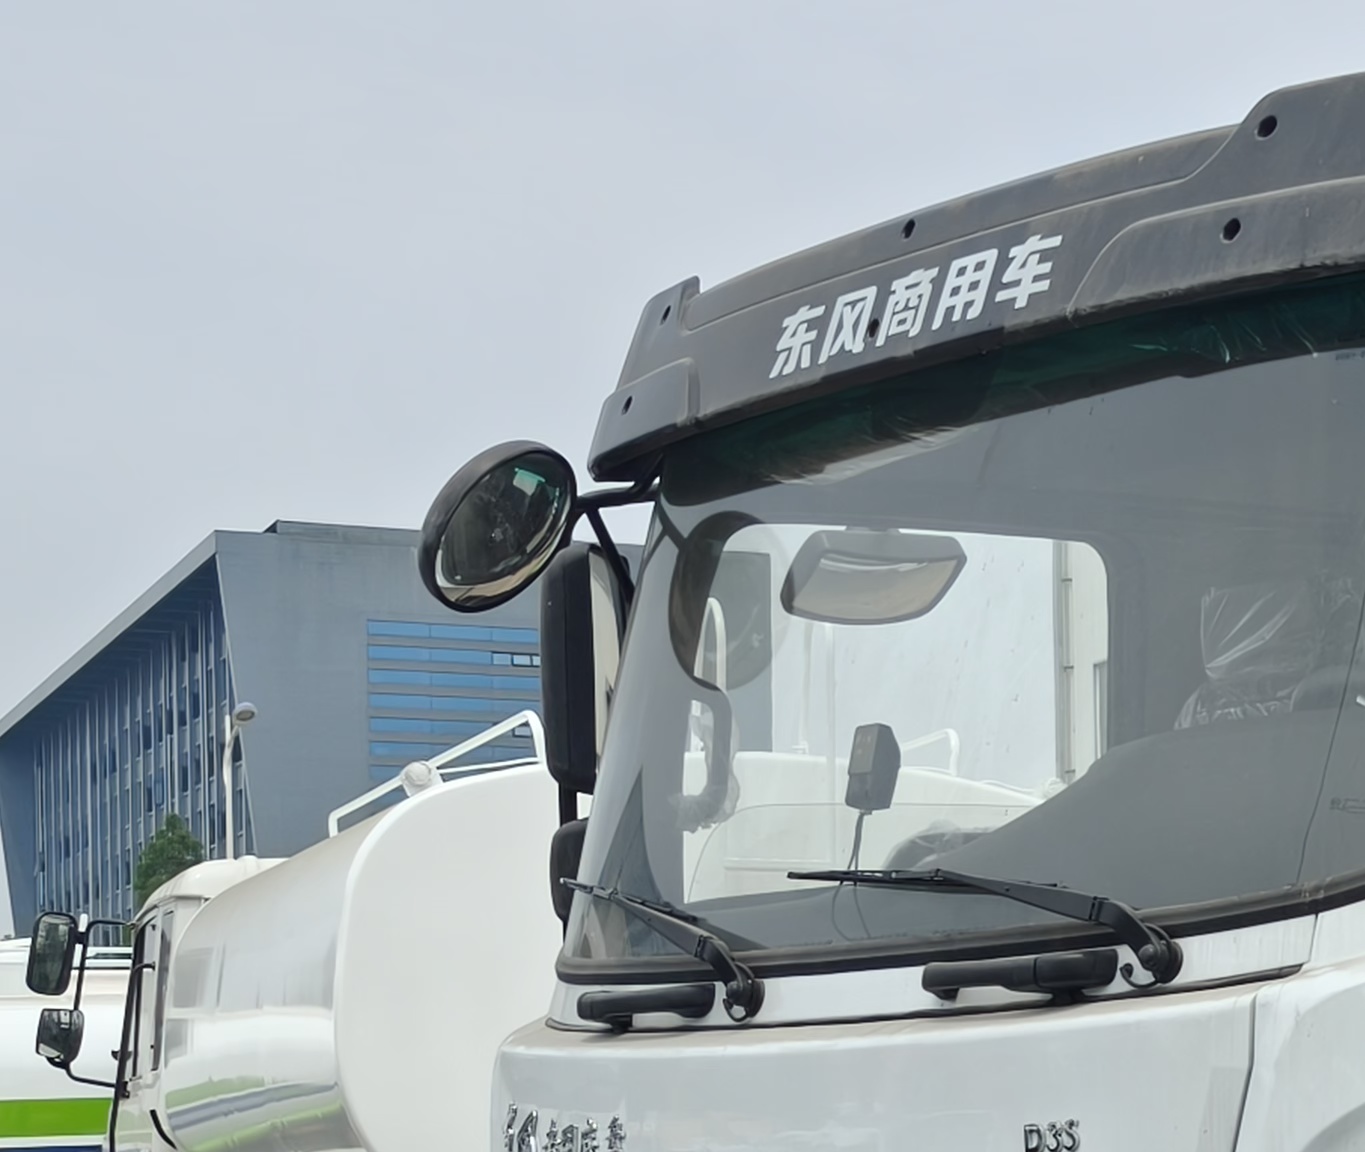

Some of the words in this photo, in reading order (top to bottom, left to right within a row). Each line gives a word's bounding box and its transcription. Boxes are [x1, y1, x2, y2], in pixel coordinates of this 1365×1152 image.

[769, 234, 1063, 380] 东风商用车
